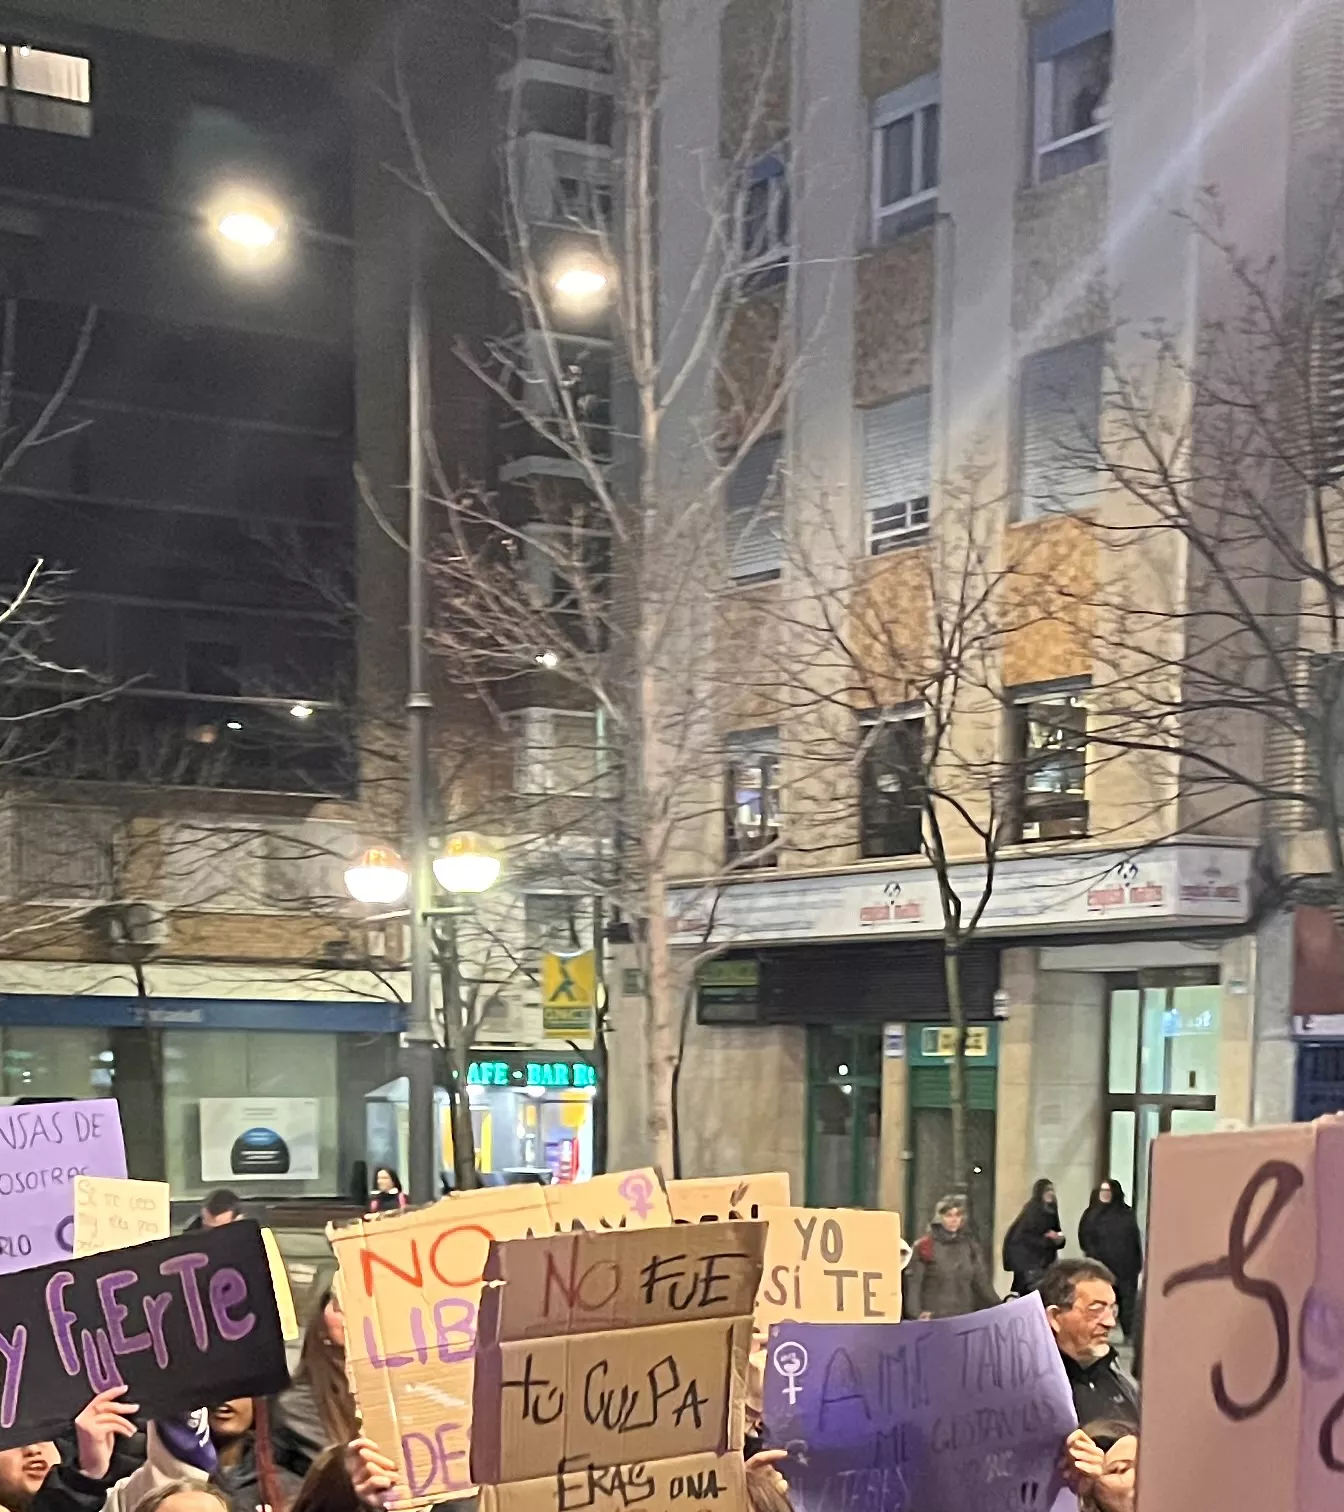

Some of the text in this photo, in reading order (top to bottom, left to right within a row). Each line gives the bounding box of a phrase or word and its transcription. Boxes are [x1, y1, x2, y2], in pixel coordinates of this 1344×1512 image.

[467, 1062, 509, 1085] AFE
[526, 1062, 570, 1086] BAR
[74, 1111, 105, 1142] DE
[360, 1224, 495, 1297] NO
[793, 1217, 845, 1264] YO
[542, 1234, 749, 1318] NO FUE
[823, 1269, 886, 1318] TE
[363, 1297, 477, 1369] LIB
[401, 1421, 472, 1496] DE
